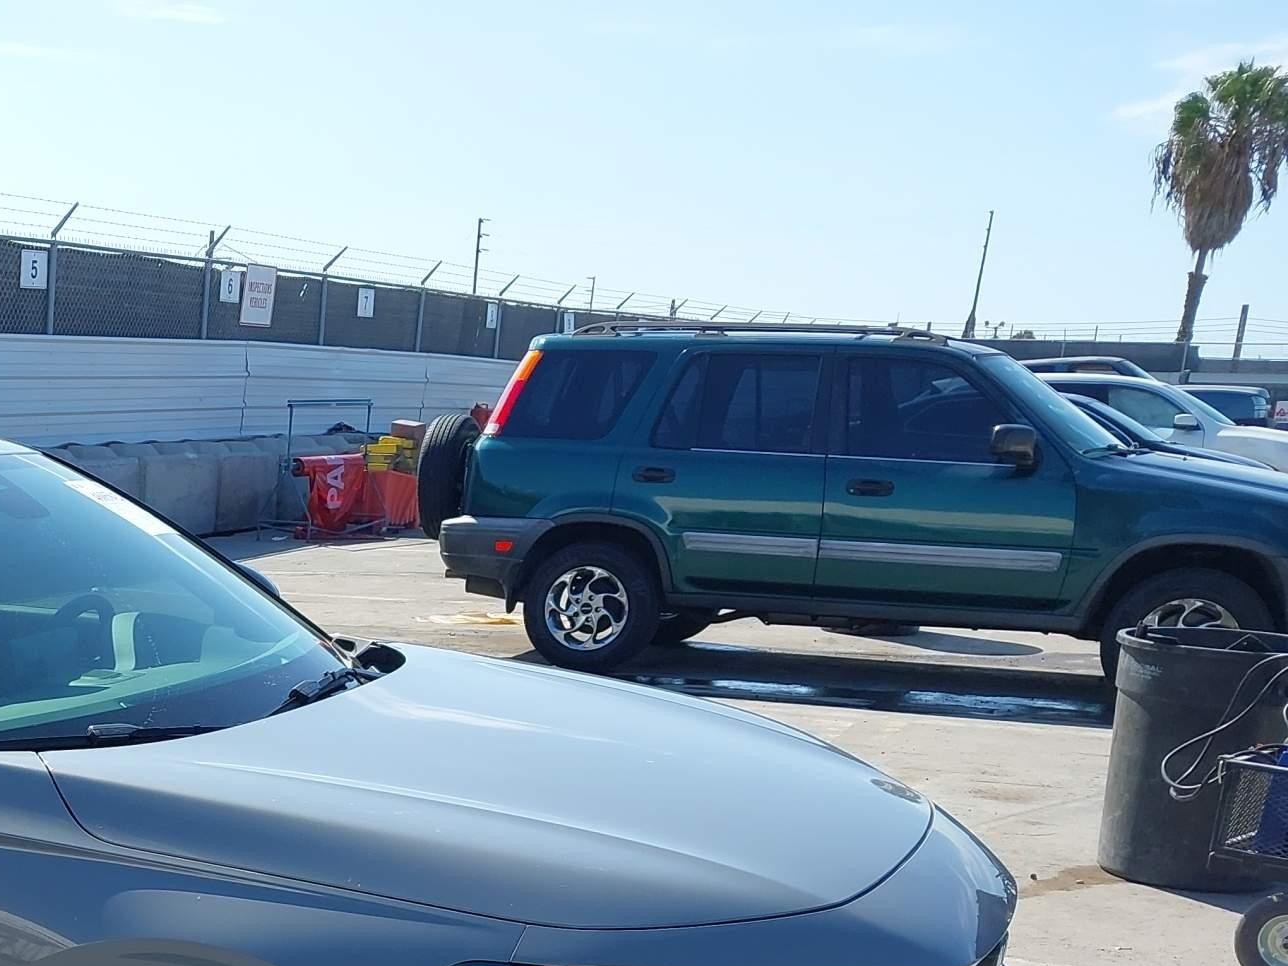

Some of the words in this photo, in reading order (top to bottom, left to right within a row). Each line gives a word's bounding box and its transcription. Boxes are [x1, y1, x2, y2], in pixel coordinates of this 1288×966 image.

[30, 259, 38, 279] 5
[227, 278, 233, 294] 6
[364, 295, 369, 311] 7
